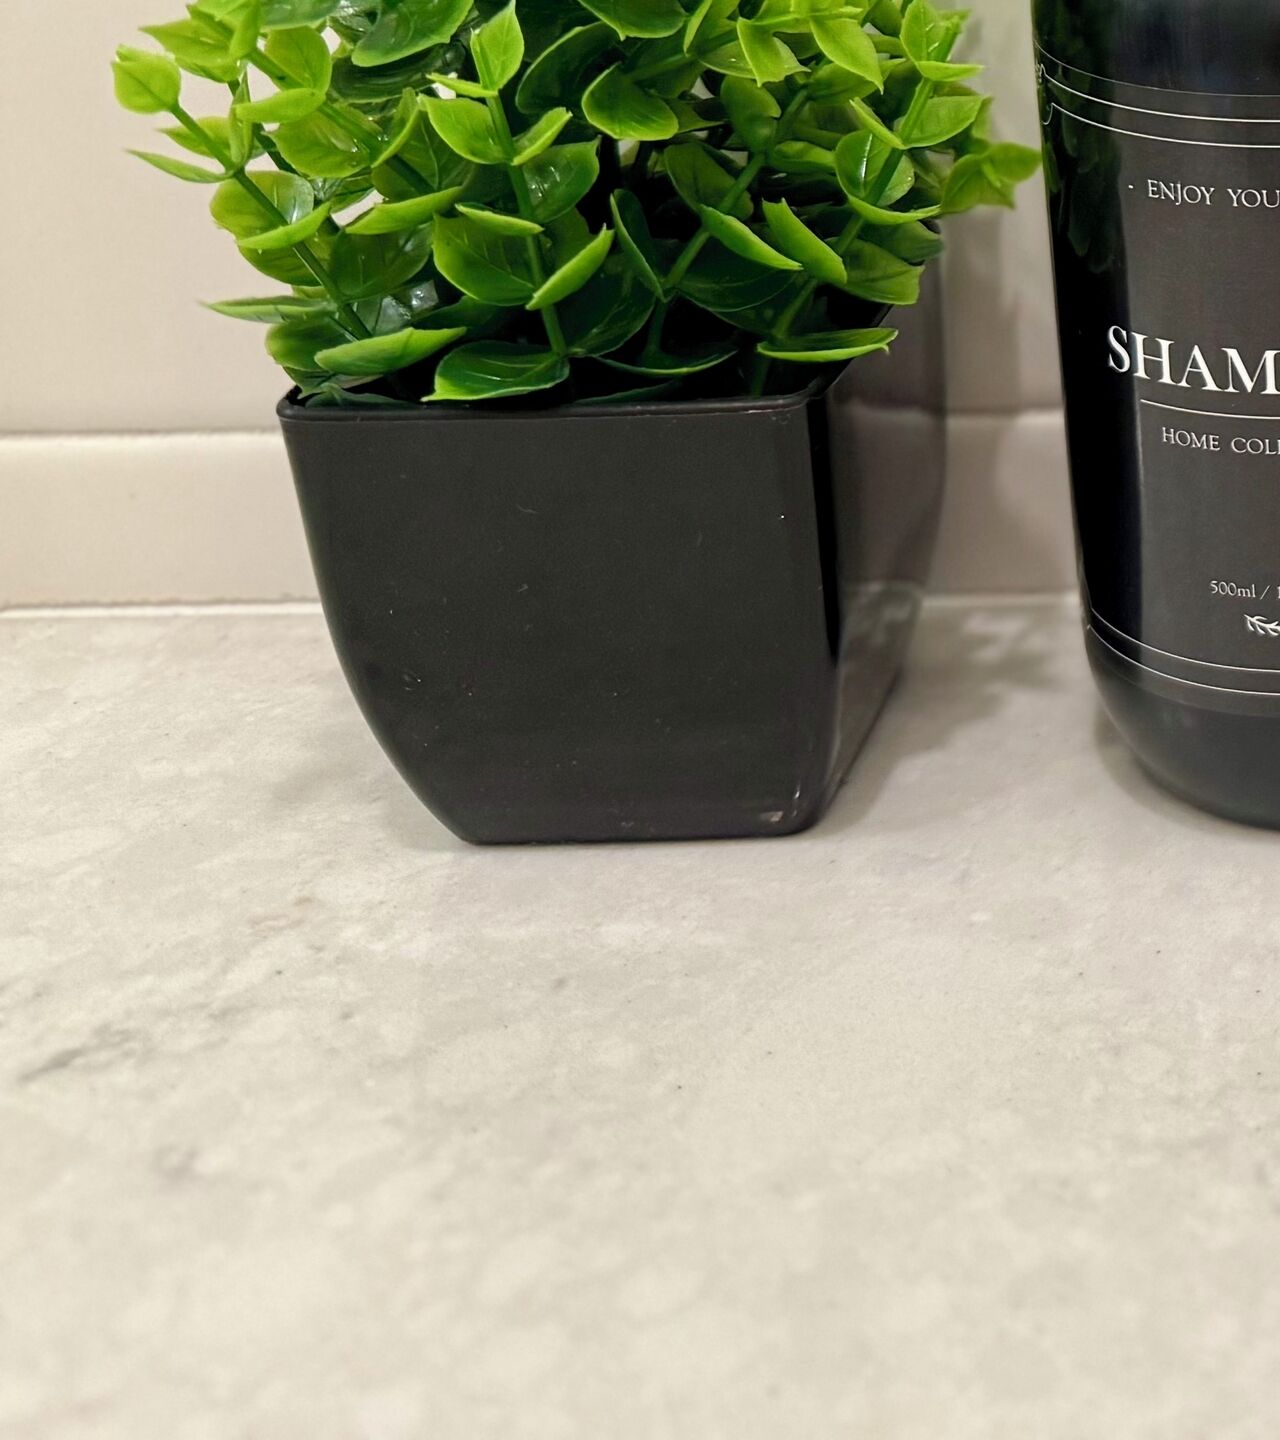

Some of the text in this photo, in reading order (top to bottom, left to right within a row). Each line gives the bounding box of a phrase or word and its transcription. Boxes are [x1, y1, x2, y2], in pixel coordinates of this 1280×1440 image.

[1147, 178, 1215, 206] ENJOY
[1161, 426, 1221, 452] HOME
[1210, 580, 1256, 598] 500ml
